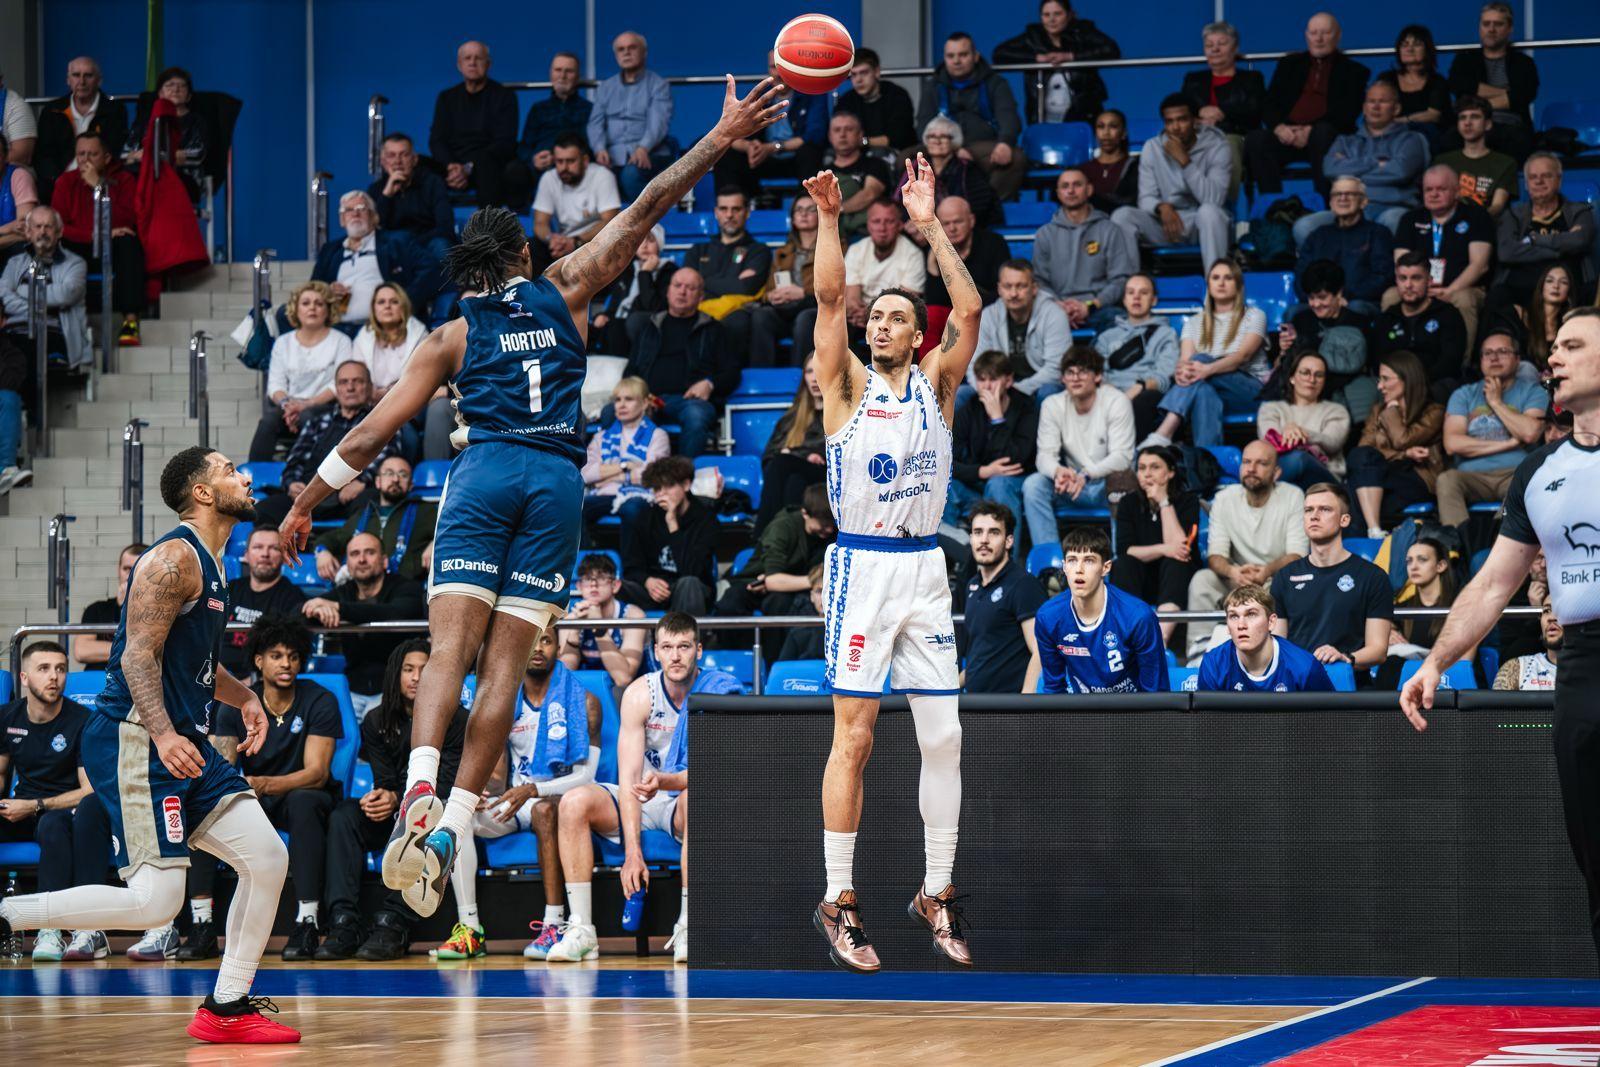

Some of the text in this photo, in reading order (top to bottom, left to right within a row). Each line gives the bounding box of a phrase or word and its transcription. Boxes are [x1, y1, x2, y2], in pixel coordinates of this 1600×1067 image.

[797, 49, 834, 60] molten
[499, 328, 557, 353] HORTON
[522, 358, 543, 413] 1
[1544, 478, 1566, 492] 4F
[454, 558, 499, 575] Dantex
[511, 570, 553, 590] netuno
[1561, 569, 1590, 585] Bank
[1063, 634, 1079, 642] 4F
[1107, 649, 1125, 673] 2
